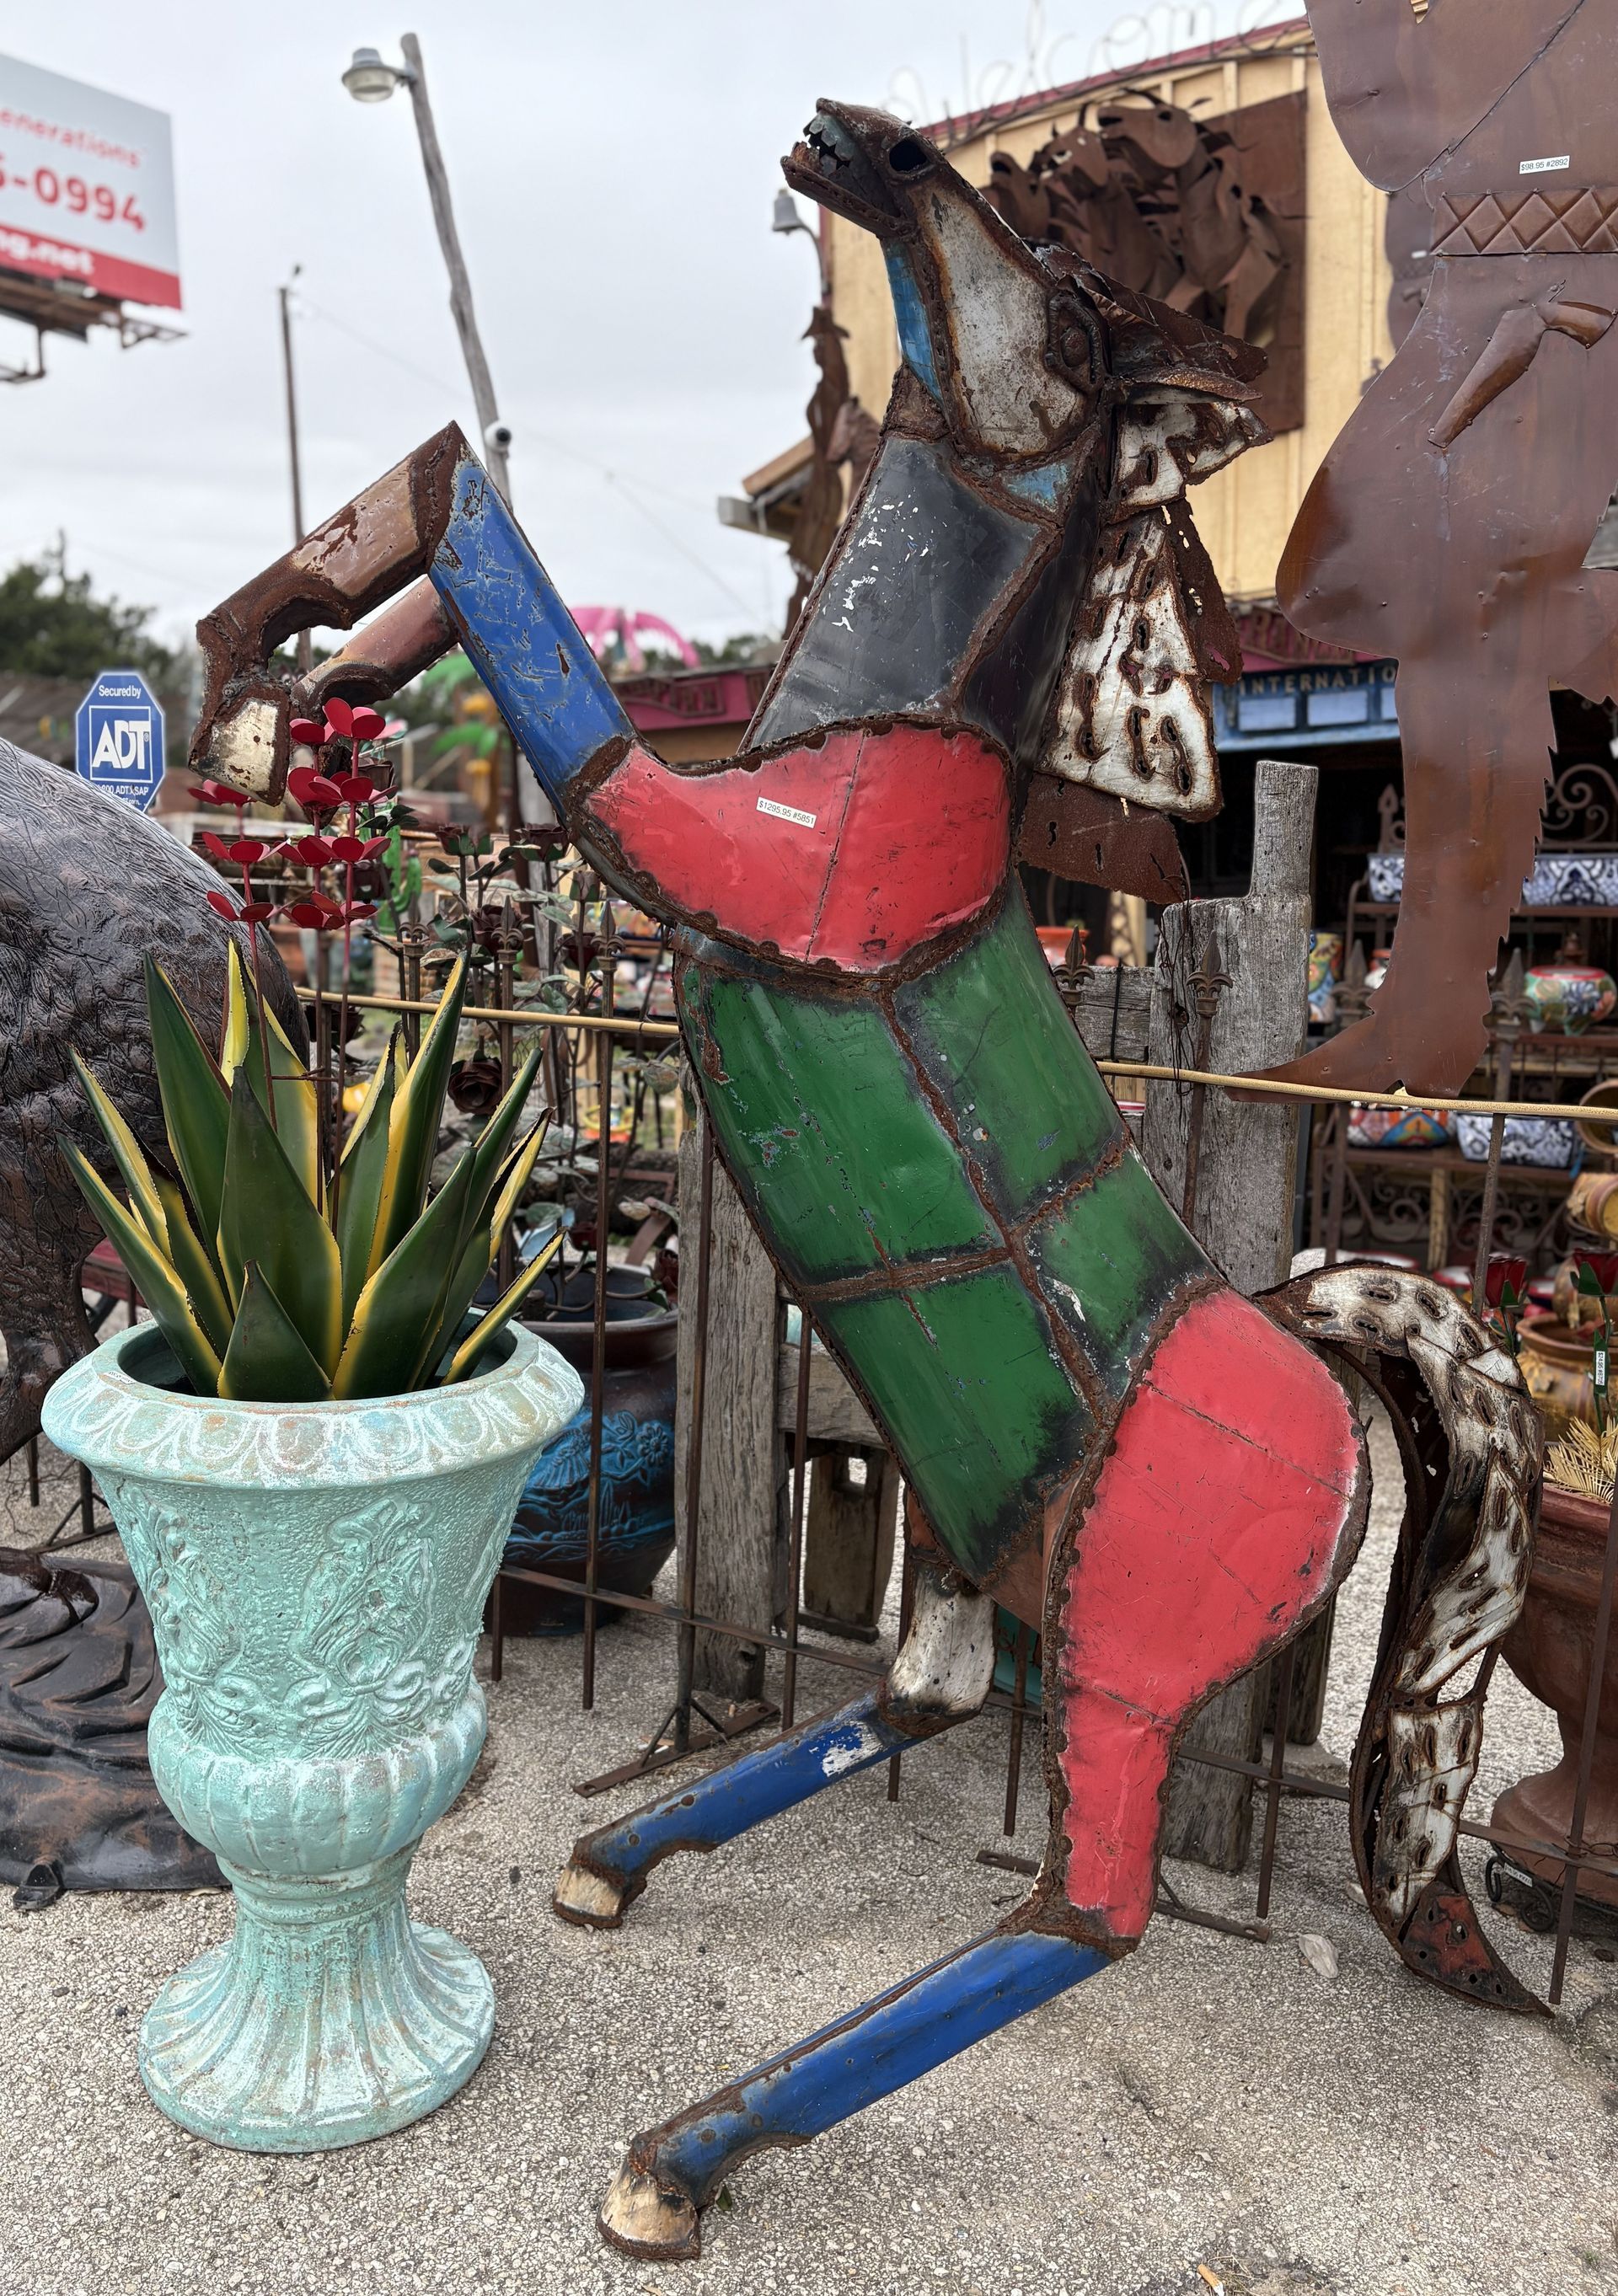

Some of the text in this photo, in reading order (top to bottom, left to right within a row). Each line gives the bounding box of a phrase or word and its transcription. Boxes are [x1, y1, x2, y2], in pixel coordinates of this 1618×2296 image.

[0, 153, 146, 234] -0994
[99, 685, 142, 699] Secured by
[92, 720, 150, 769] ADT
[758, 800, 814, 824] $1295.95 #5851
